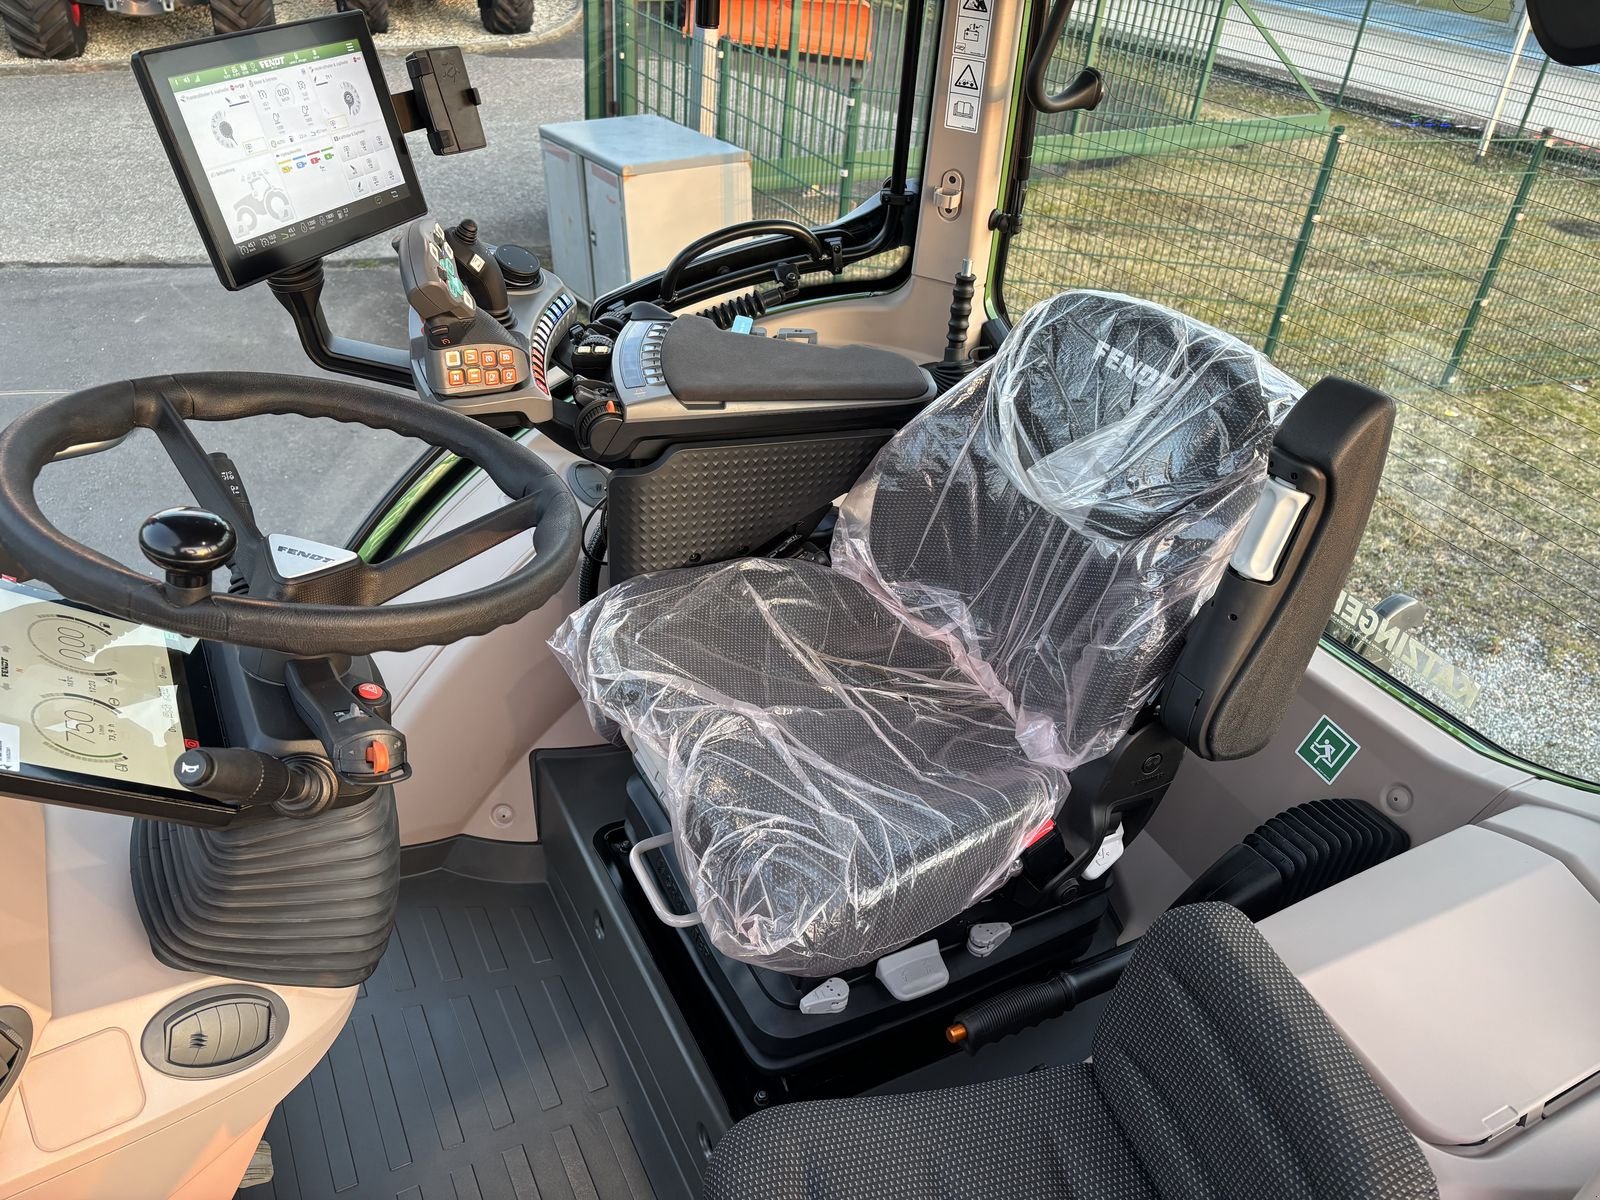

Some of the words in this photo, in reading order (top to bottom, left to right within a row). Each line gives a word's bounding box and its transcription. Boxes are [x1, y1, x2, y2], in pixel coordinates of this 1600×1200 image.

[259, 57, 285, 68] FENDT
[277, 545, 336, 563] FENDT
[1, 656, 9, 678] FENDT
[64, 709, 96, 744] 750
